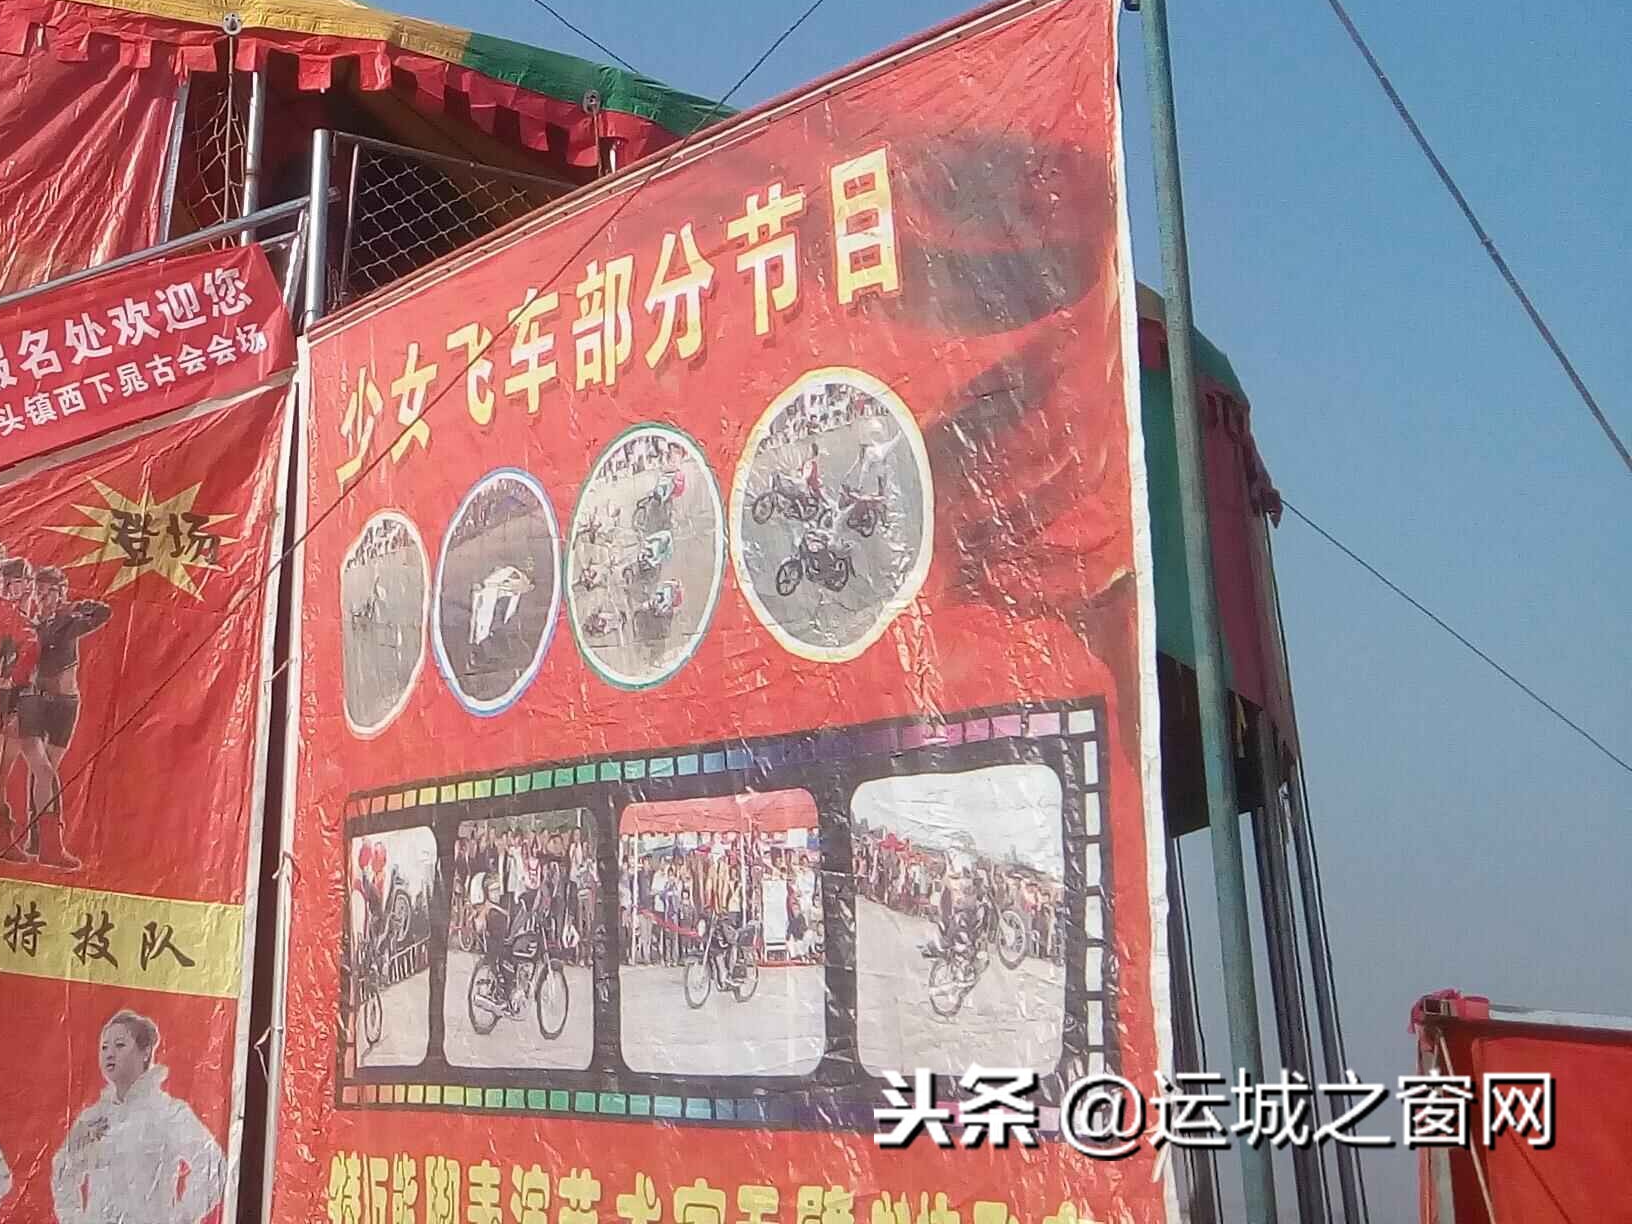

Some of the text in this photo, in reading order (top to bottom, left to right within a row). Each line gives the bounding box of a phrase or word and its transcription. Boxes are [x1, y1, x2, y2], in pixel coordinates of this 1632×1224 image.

[334, 146, 902, 484] 少女飞车部分节目
[107, 508, 220, 568] 登场
